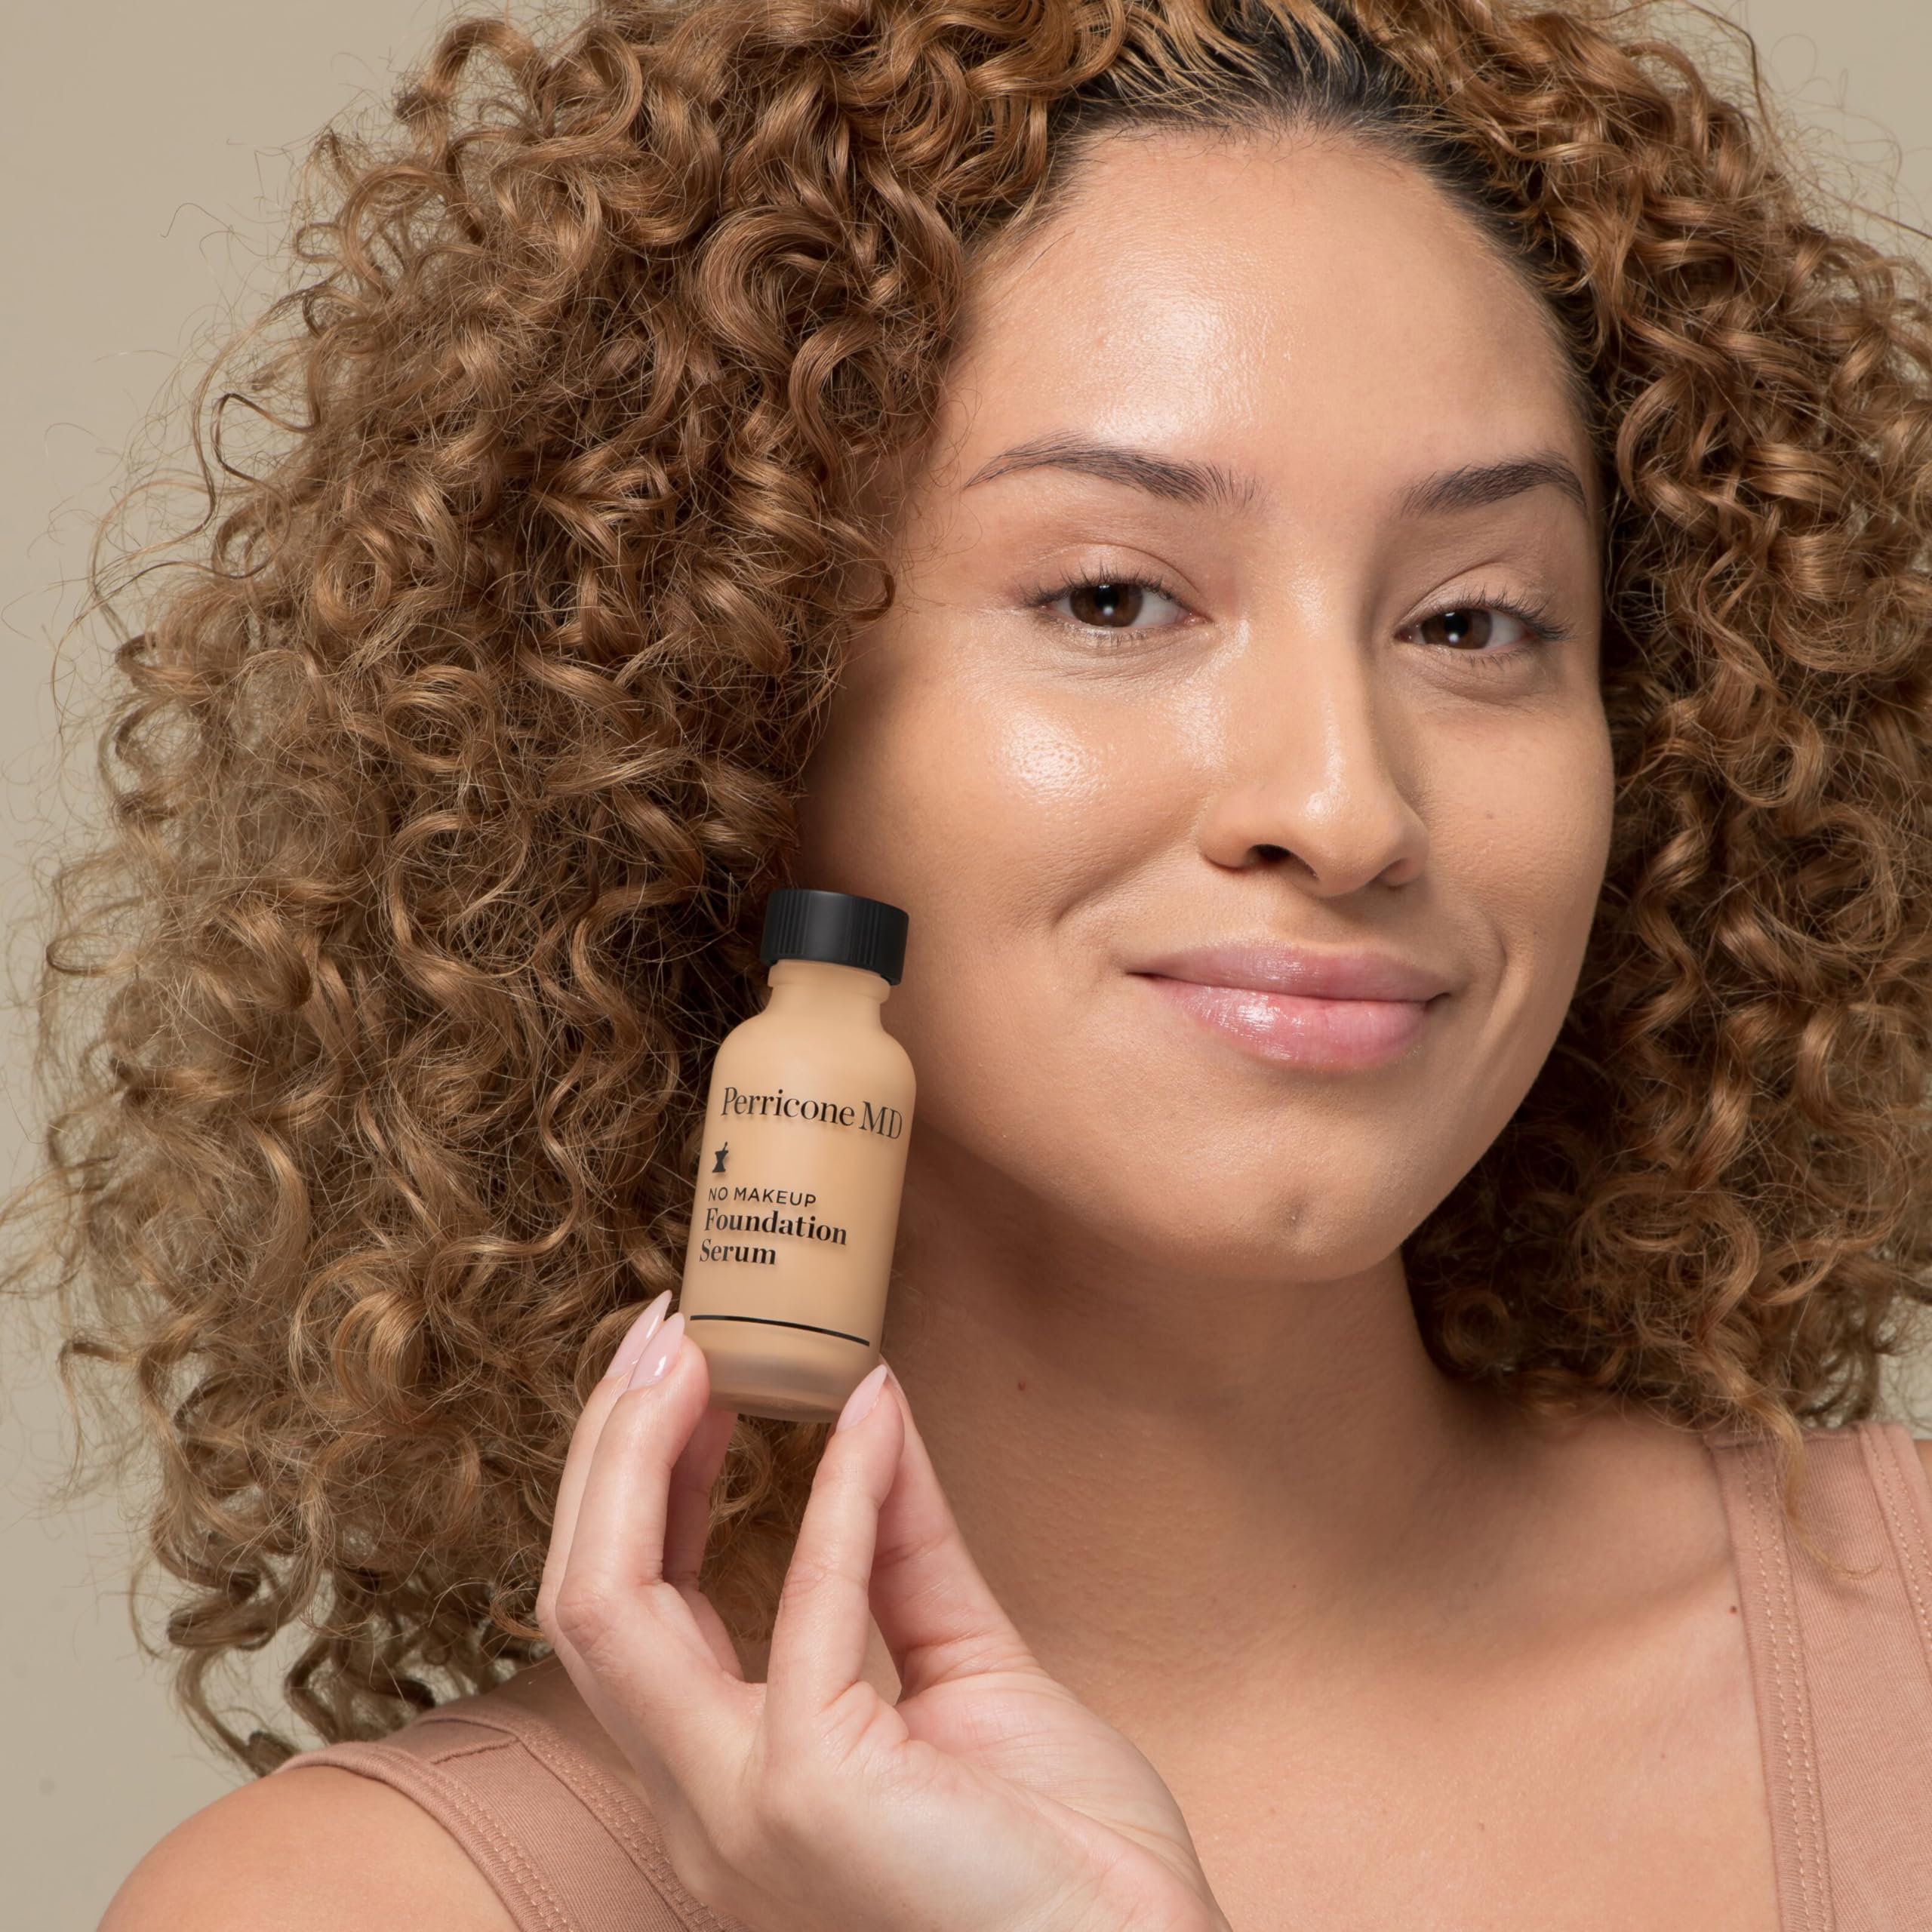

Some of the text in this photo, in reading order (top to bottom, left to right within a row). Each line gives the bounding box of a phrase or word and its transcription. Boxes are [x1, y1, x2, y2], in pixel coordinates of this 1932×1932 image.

[720, 1087, 903, 1140] Perricone MD
[708, 1186, 817, 1208] NO MAKEUP
[704, 1208, 847, 1245] Foundation
[699, 1238, 777, 1265] Serum
